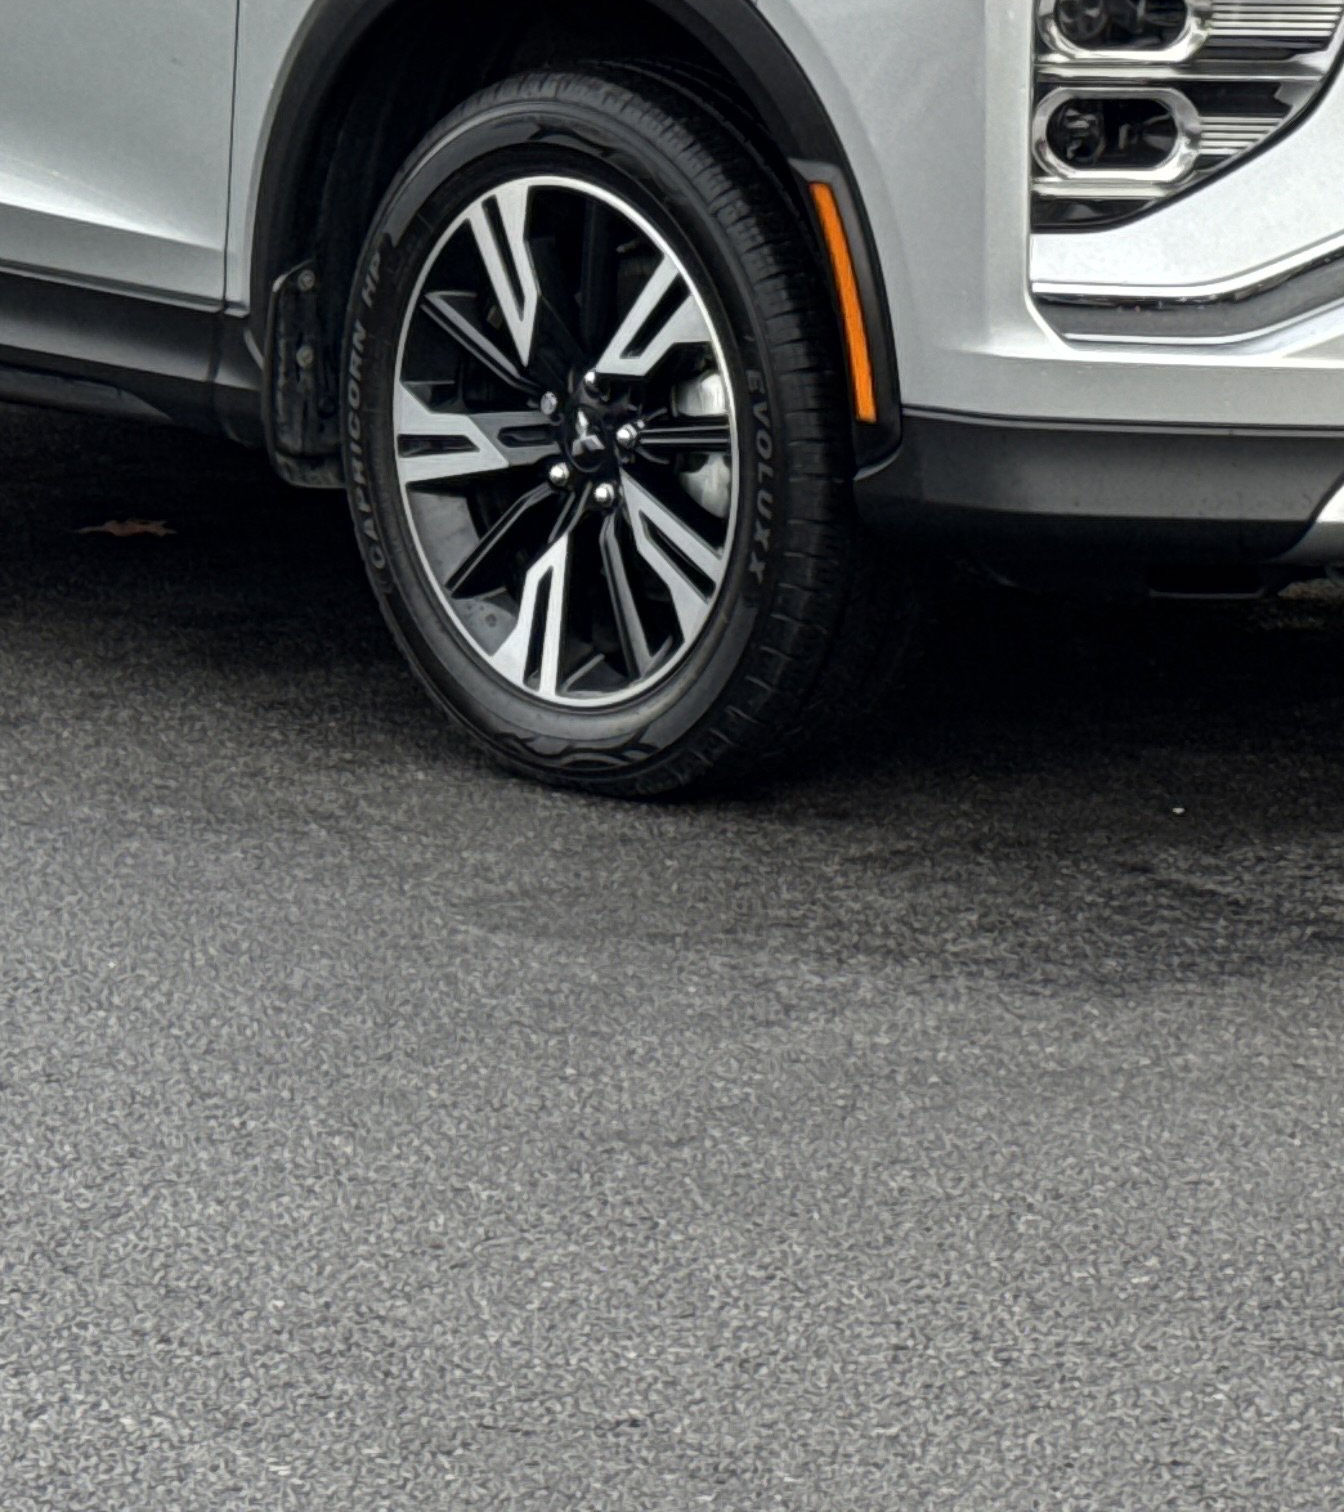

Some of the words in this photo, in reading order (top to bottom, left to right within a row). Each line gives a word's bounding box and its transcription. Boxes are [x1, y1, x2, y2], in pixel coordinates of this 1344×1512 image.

[361, 251, 382, 308] HP
[347, 319, 386, 570] CAPRICORN
[746, 370, 774, 584] EVOLUXX
